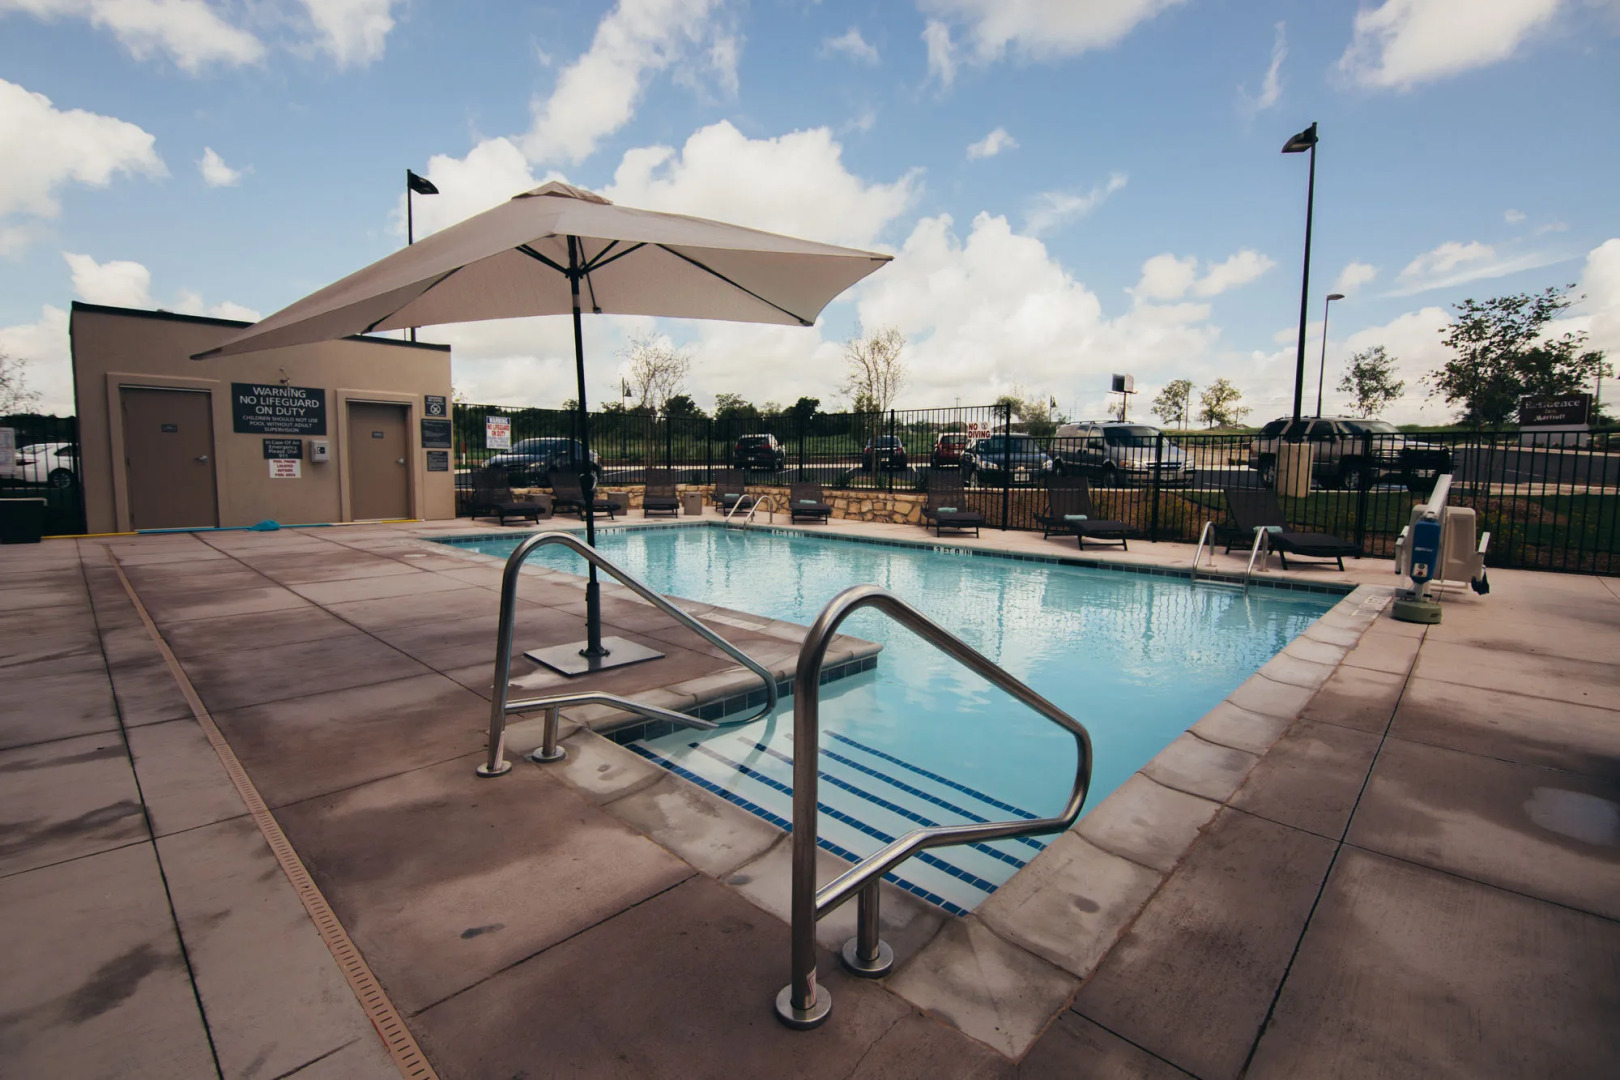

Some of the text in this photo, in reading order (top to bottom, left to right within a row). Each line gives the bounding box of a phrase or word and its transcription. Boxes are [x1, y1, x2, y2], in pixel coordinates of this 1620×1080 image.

[253, 386, 306, 398] WARNING
[240, 396, 319, 408] NO LIFEGUARD
[255, 406, 306, 416] ON DUTY
